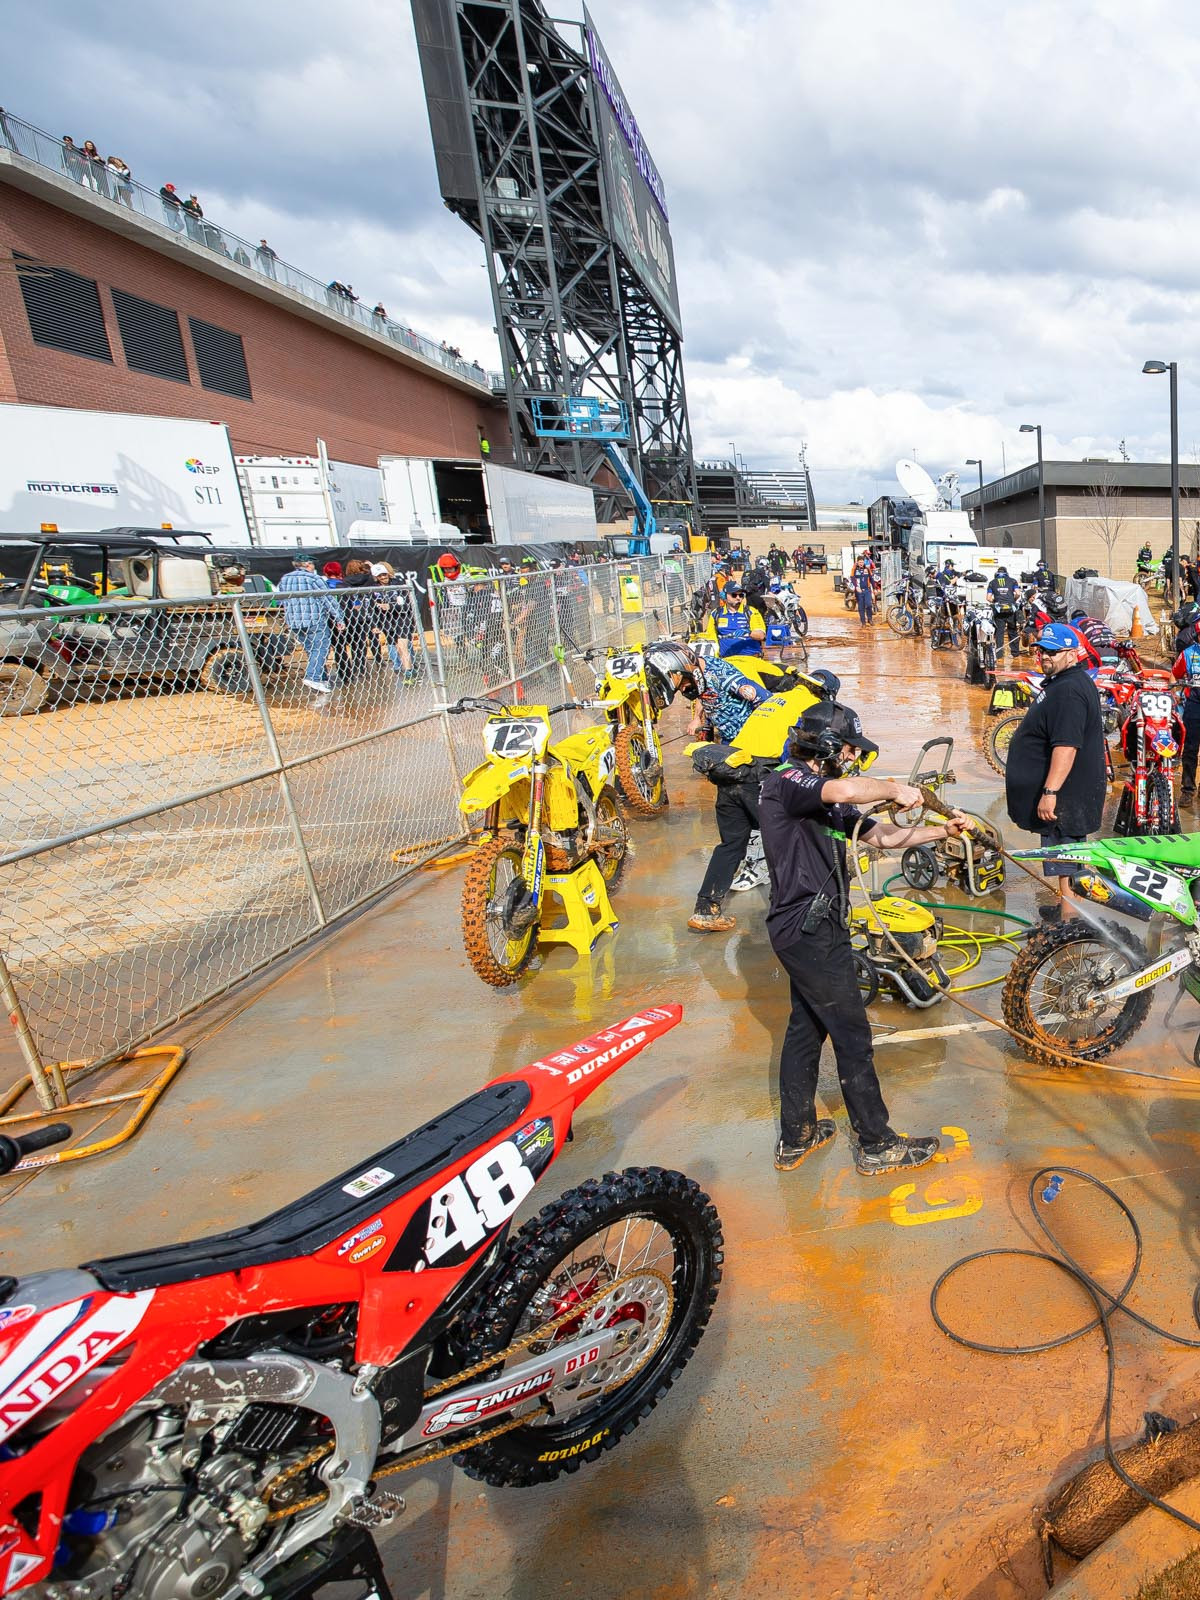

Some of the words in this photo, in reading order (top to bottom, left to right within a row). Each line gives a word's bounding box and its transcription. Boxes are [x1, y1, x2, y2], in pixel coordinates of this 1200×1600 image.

[197, 466, 220, 475] NEP
[27, 483, 119, 494] MOTOCROSS
[194, 486, 223, 504] ST1
[612, 657, 638, 675] 94
[1141, 694, 1172, 717] 39
[491, 724, 538, 752] 12
[1057, 853, 1092, 861] MAXXIS
[1128, 866, 1168, 902] 22
[1135, 962, 1172, 988] CIRCUIT
[566, 1031, 647, 1084] DUNLOP
[424, 1140, 536, 1264] 48
[352, 1244, 372, 1261] Twin
[372, 1238, 384, 1250] Air
[0, 1330, 126, 1433] NDA
[538, 1431, 603, 1462] DUNLOP
